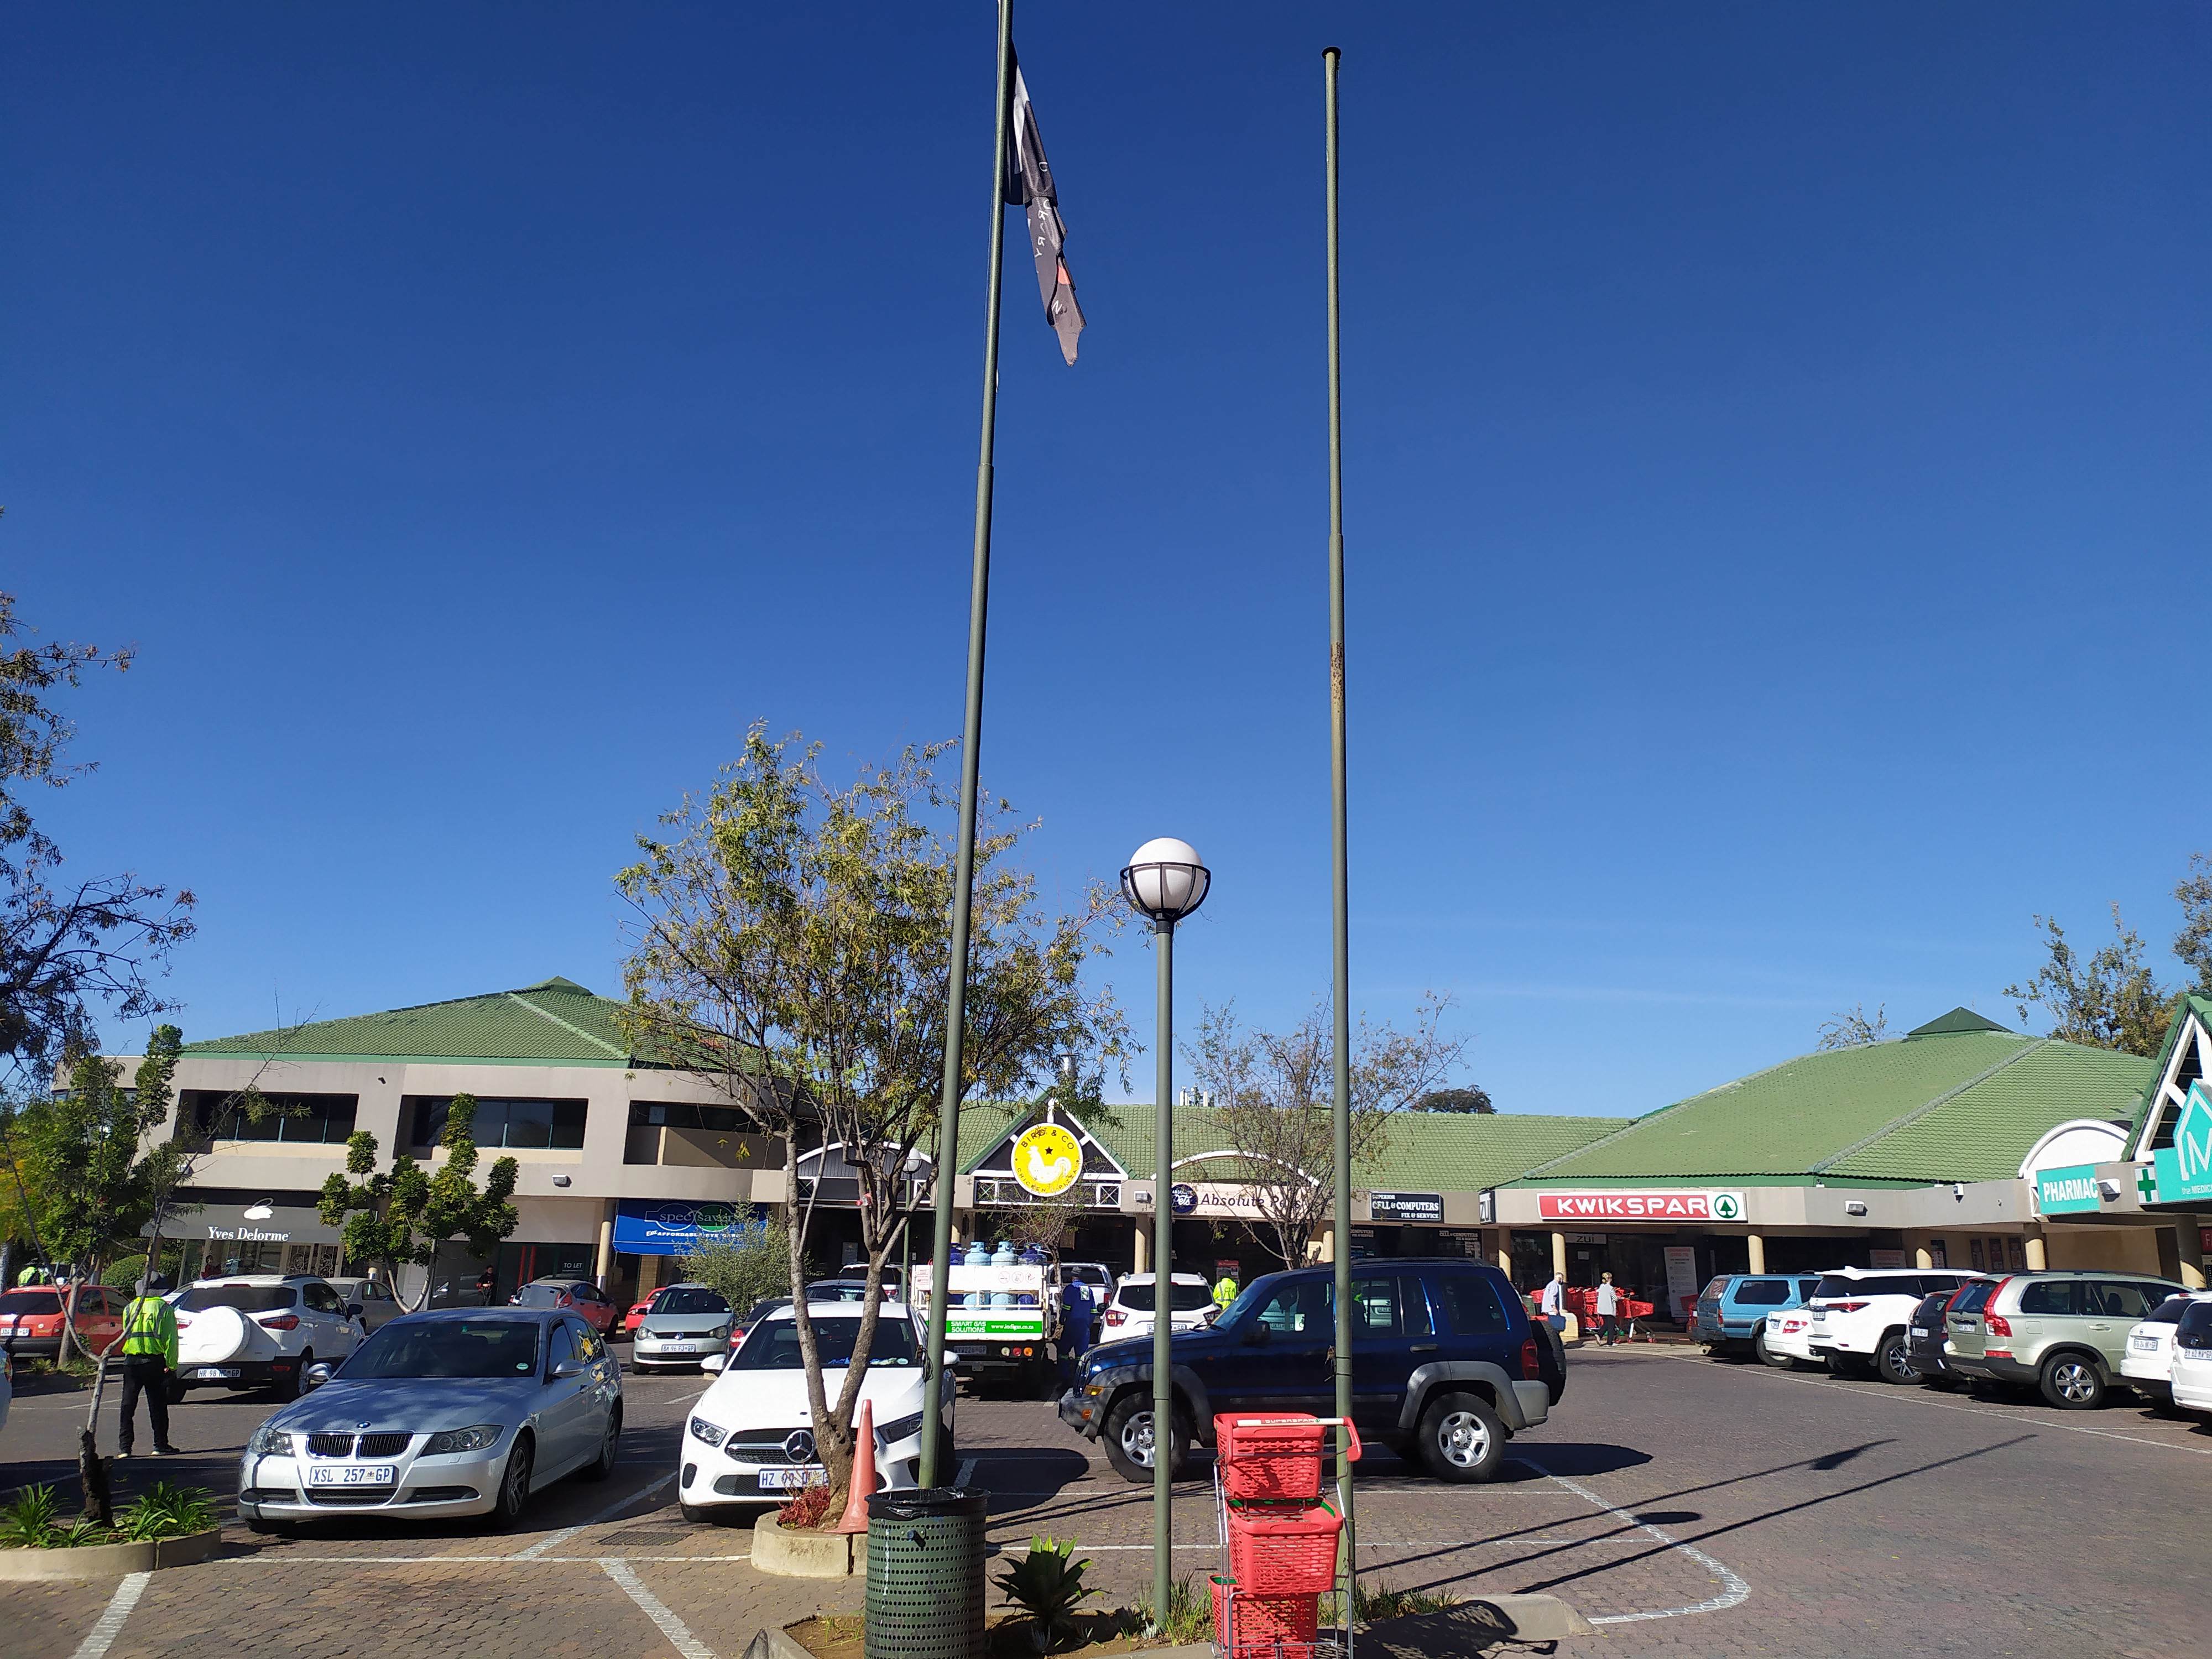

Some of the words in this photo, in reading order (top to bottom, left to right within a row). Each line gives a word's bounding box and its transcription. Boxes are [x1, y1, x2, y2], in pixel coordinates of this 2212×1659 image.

[1062, 1135, 1074, 1149] CO
[1017, 1167, 1046, 1192] CHICKEN
[1201, 1193, 1265, 1207] Absolute
[1270, 1196, 1301, 1209] Pes
[1396, 1202, 1438, 1211] COMPUTERS
[1557, 1198, 1707, 1215] KWIKSPAR
[208, 1226, 234, 1239] Yves
[237, 1227, 289, 1241] Delorme
[1577, 1235, 1594, 1243] zui
[314, 1469, 333, 1483] XSL
[343, 1468, 366, 1482] 257
[375, 1468, 390, 1482] GP
[761, 1473, 775, 1486] HZ
